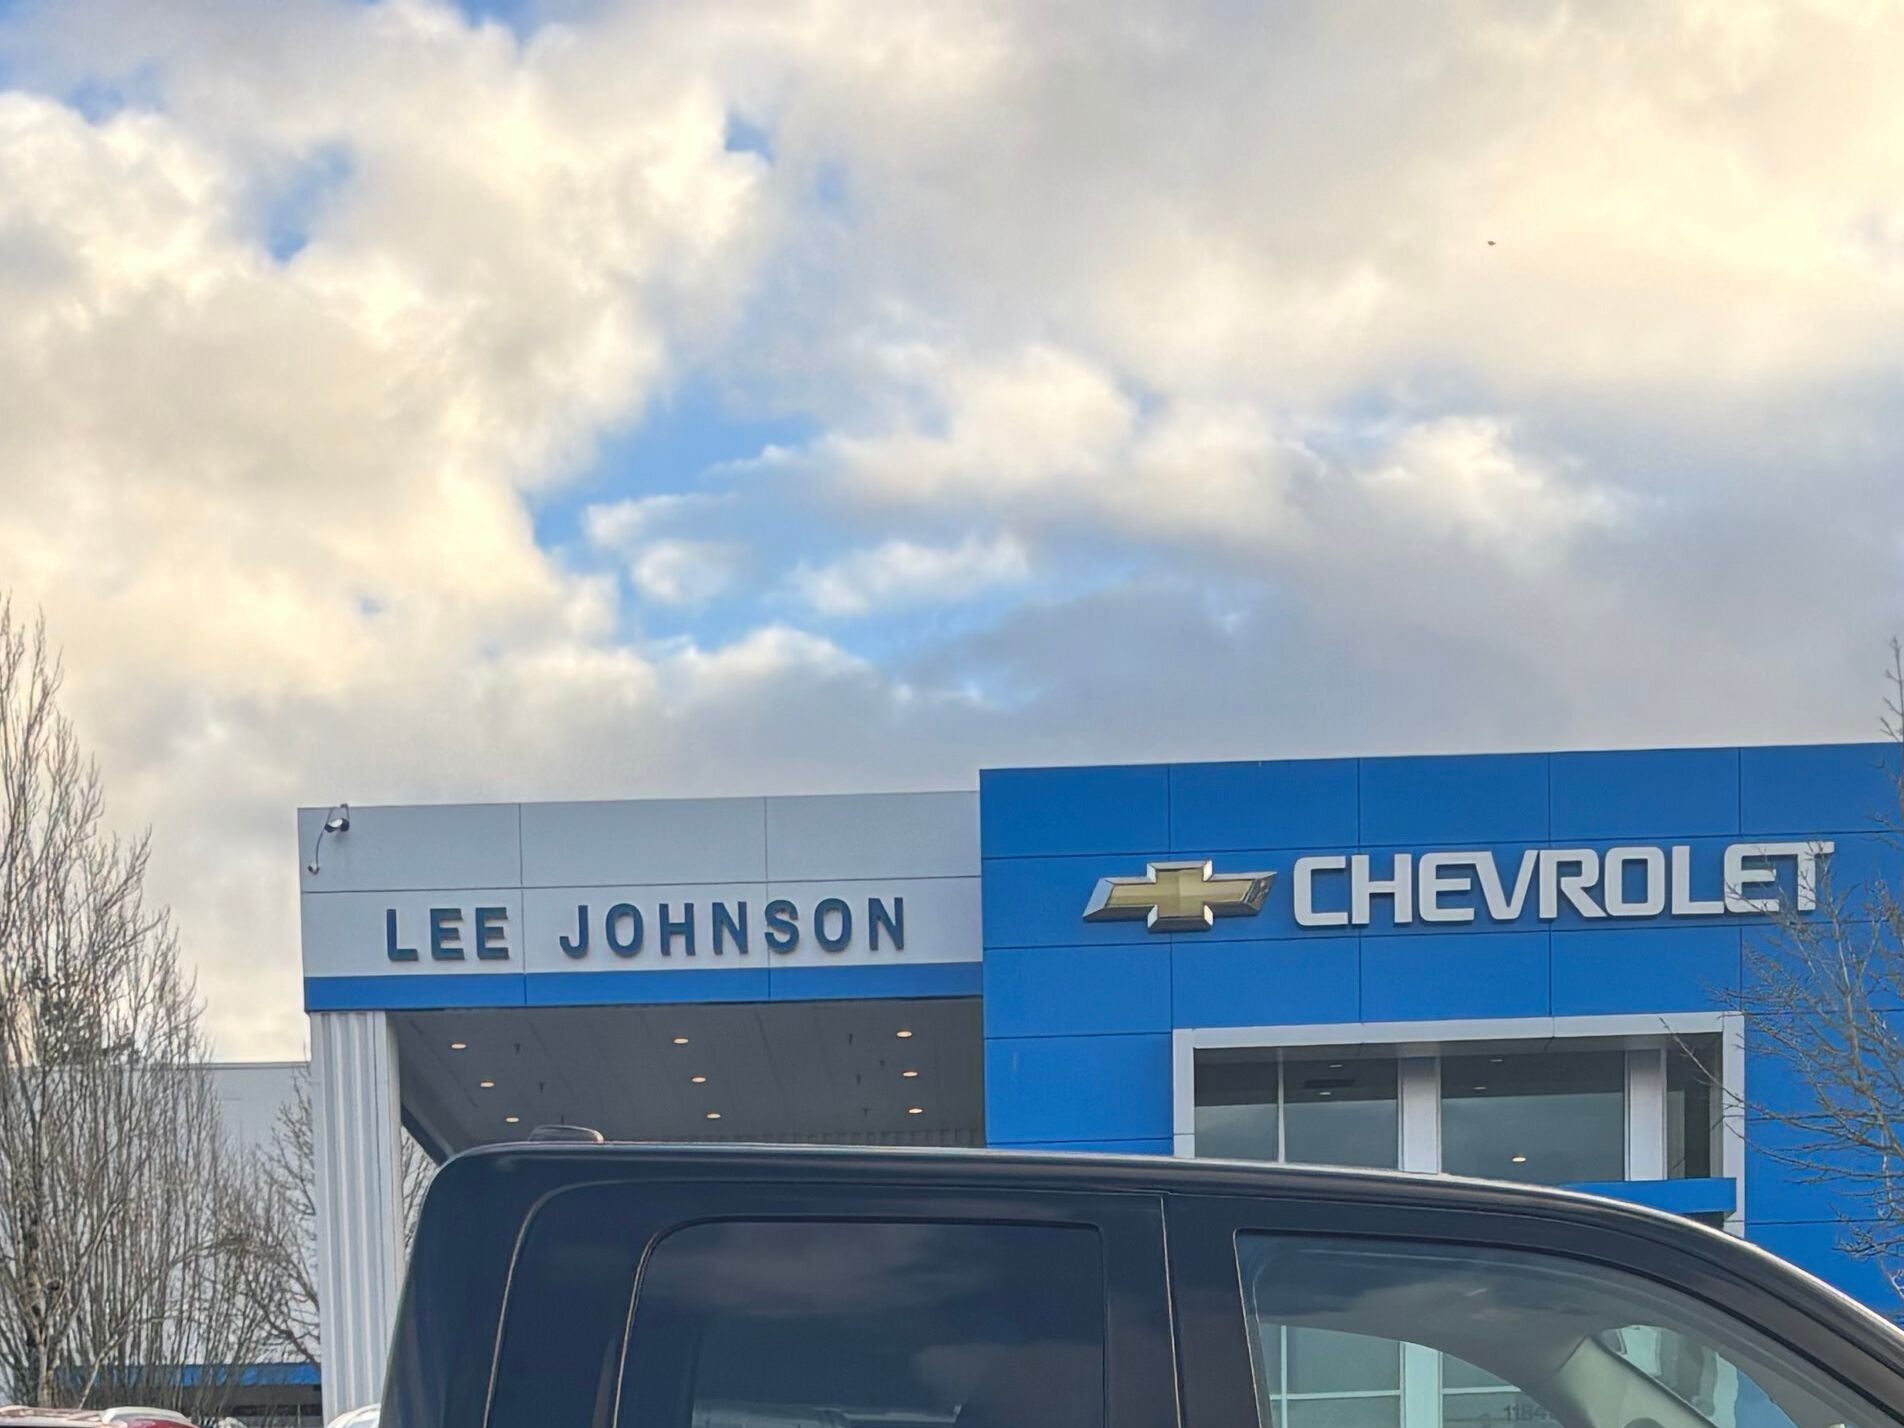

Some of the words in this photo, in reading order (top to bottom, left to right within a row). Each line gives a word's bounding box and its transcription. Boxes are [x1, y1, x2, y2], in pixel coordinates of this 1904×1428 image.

[1293, 840, 1835, 926] CHEVROLET
[386, 906, 509, 962] LEE
[558, 896, 904, 960] JOHNSON
